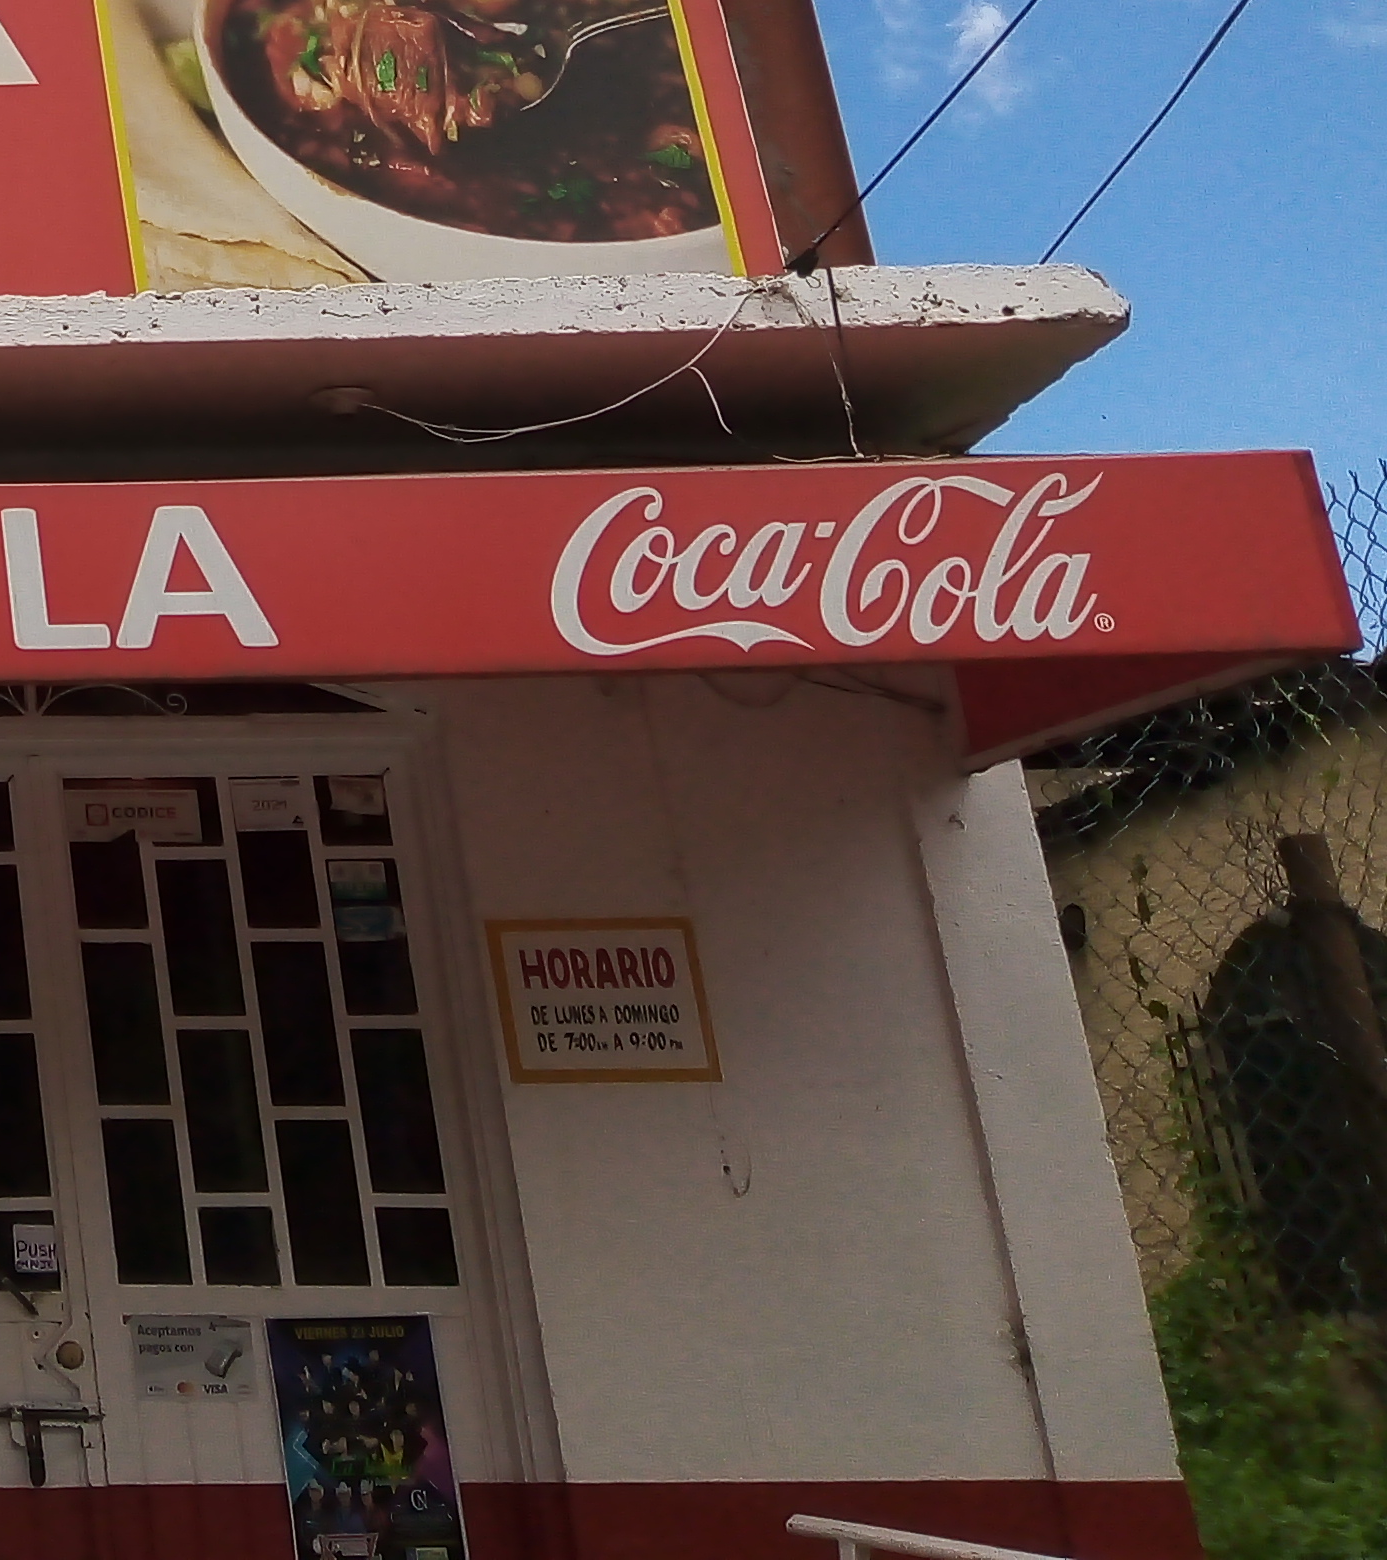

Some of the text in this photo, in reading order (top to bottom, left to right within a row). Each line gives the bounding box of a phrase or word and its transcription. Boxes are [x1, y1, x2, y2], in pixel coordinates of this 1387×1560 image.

[550, 471, 1105, 657] Coca-Cola
[518, 946, 676, 990] HORARIO
[531, 1003, 680, 1025] DE LUNES A DOMINGO
[537, 1031, 558, 1052] DE
[614, 1033, 624, 1051] A
[629, 1032, 667, 1051] 9:00
[16, 1240, 56, 1258] PUSH
[137, 1323, 202, 1338] Aceptamos
[293, 1325, 348, 1340] VIERNES
[368, 1324, 405, 1339] JULIO
[138, 1343, 195, 1356] pagos con
[202, 1384, 229, 1395] VISA
